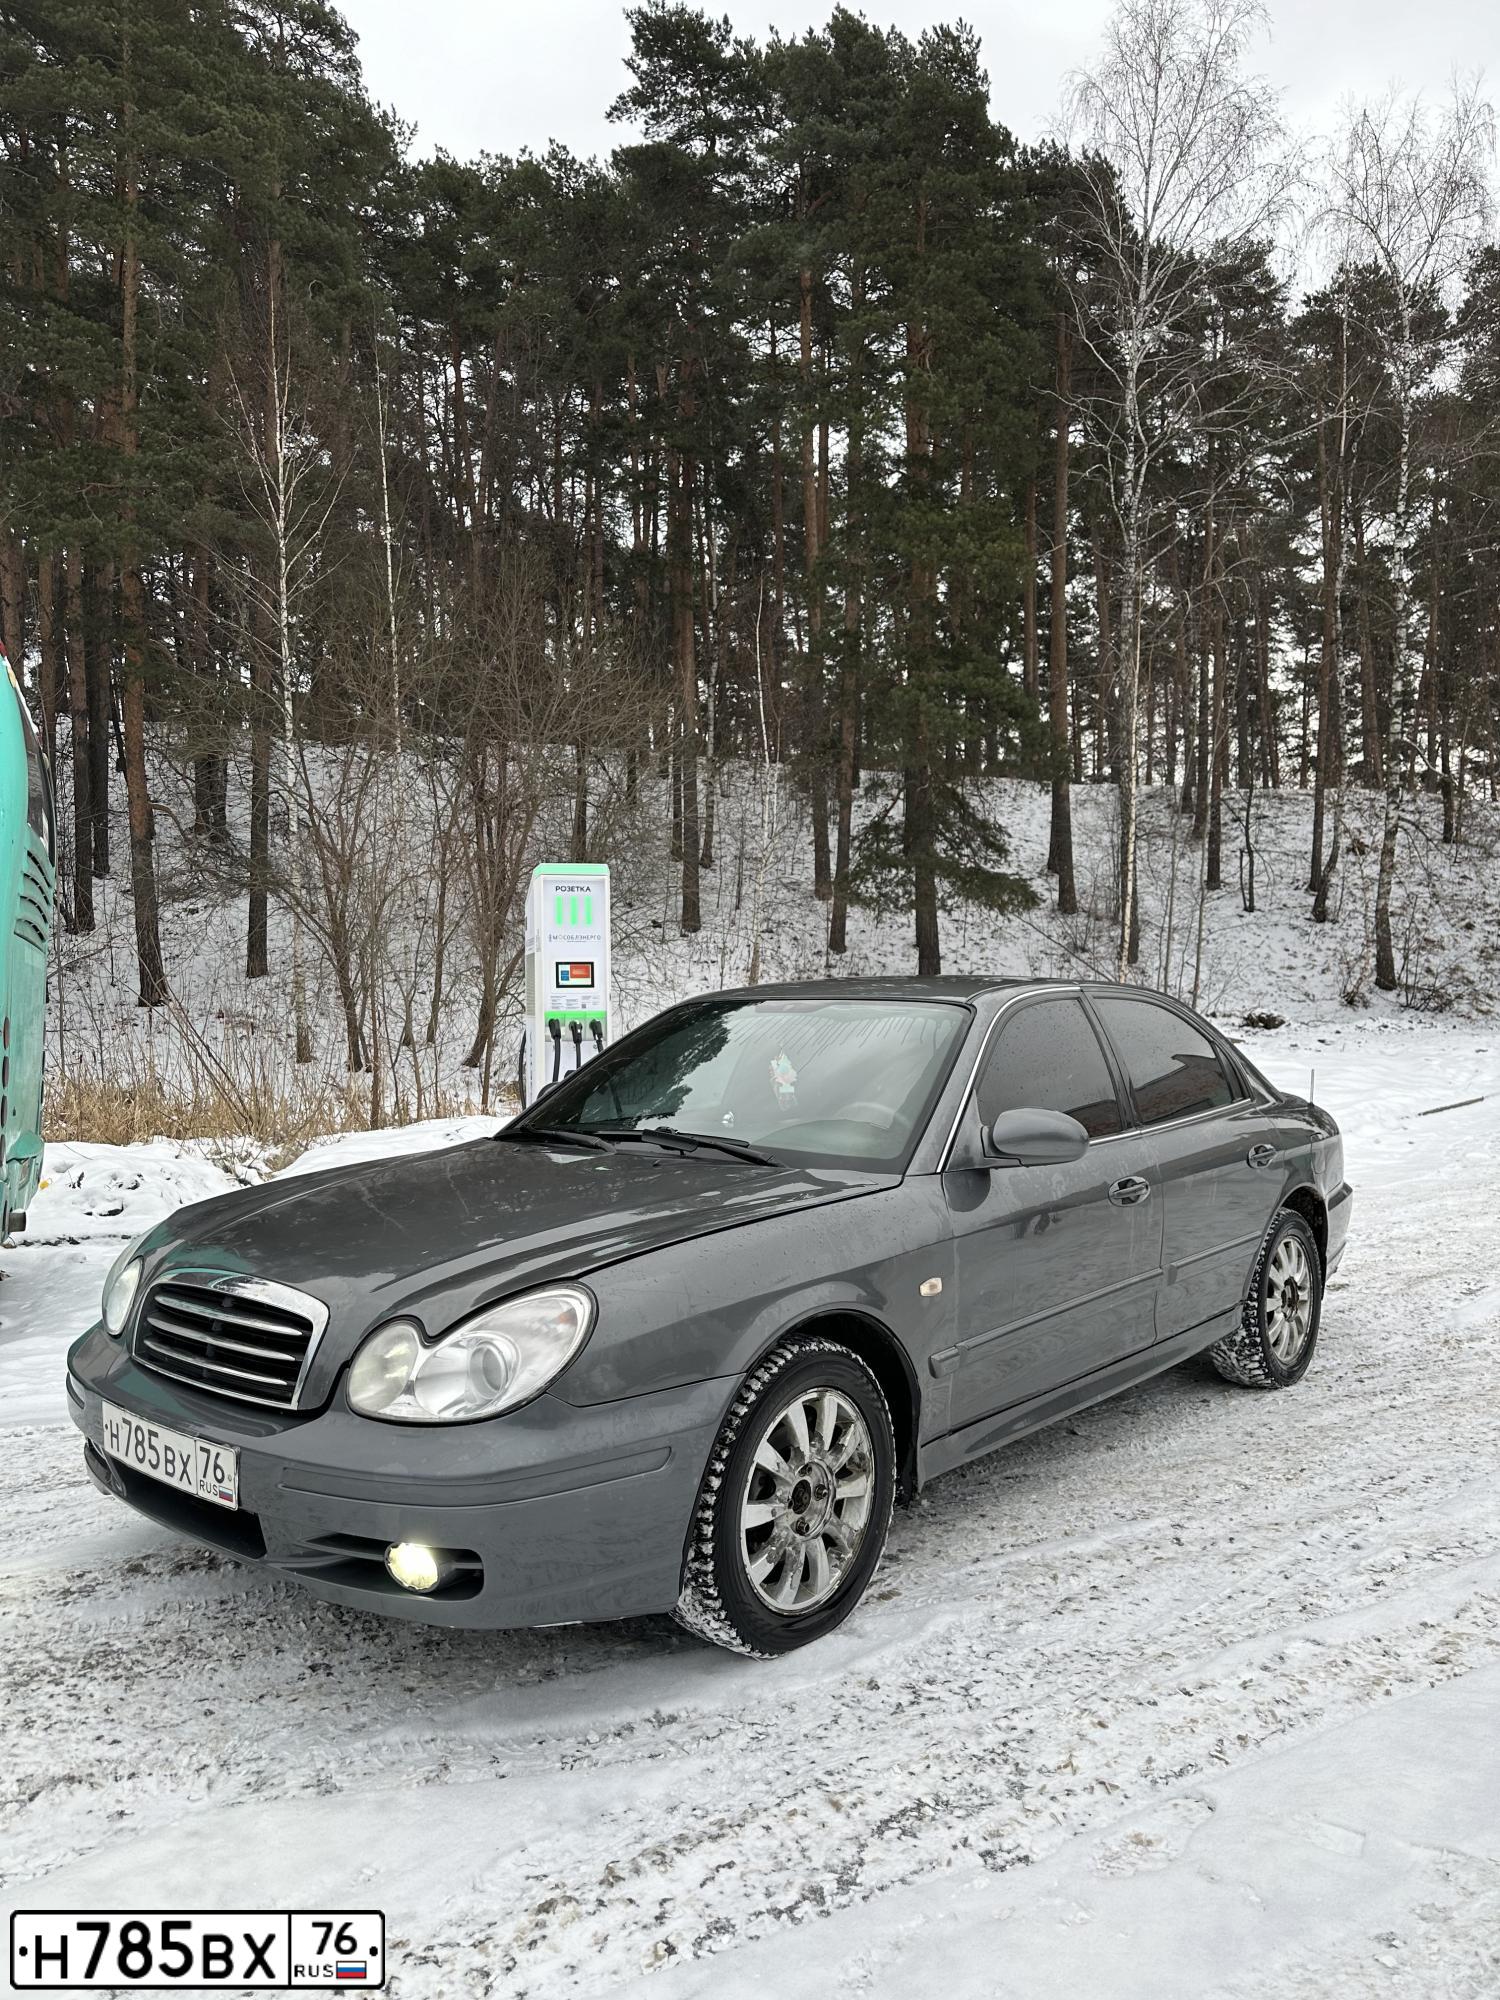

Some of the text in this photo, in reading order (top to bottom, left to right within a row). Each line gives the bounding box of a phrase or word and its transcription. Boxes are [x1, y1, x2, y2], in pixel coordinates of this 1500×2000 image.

[555, 885, 592, 893] РОЗЕТКА
[109, 1417, 225, 1486] Н785ВХ 76
[199, 1480, 219, 1496] RUS
